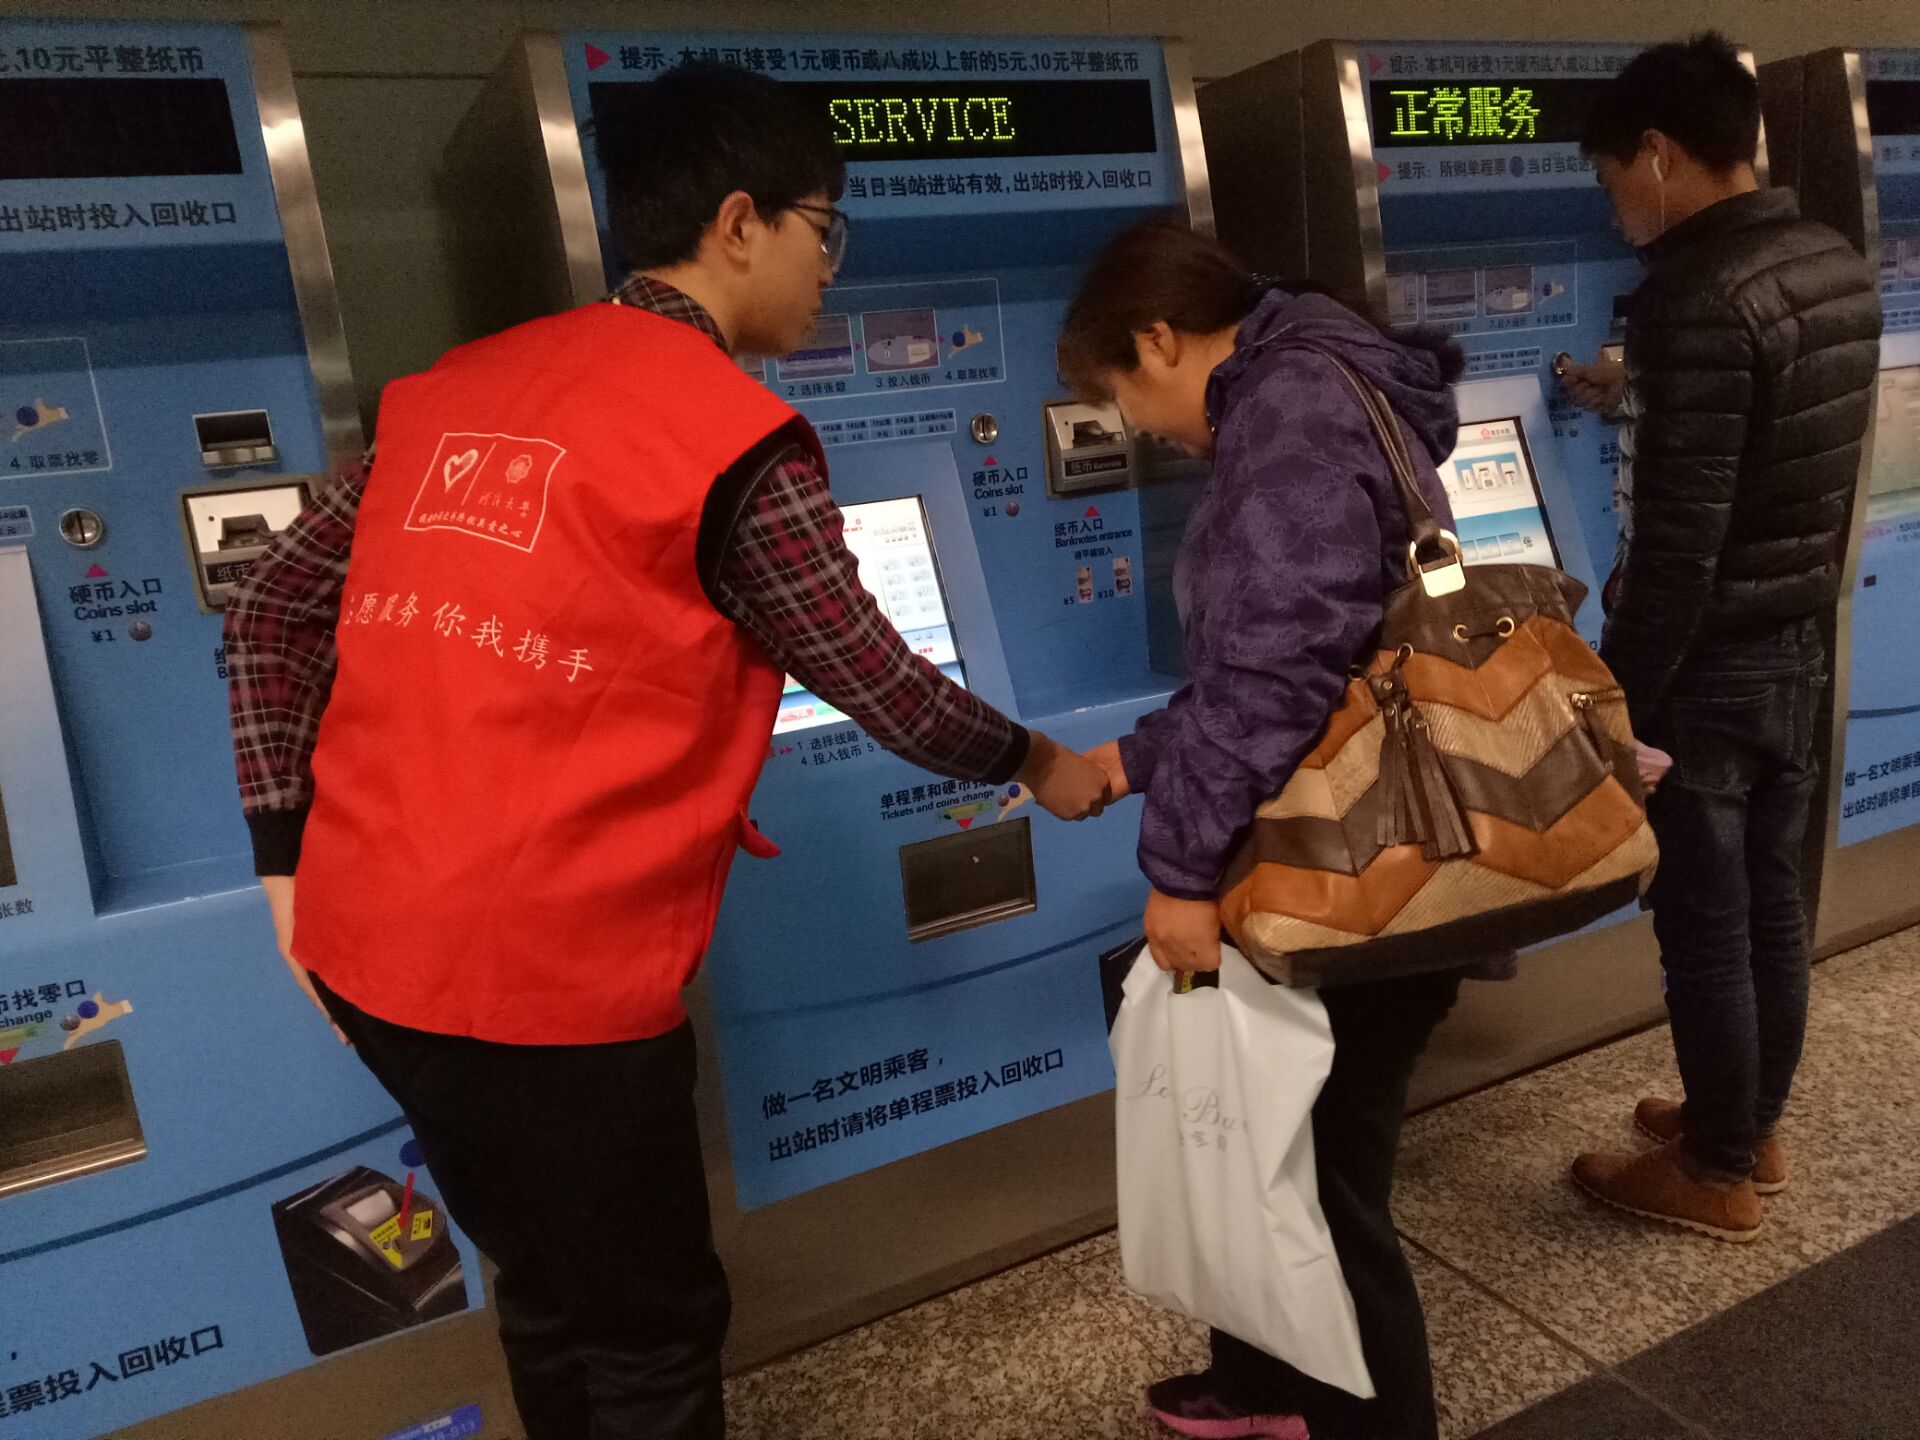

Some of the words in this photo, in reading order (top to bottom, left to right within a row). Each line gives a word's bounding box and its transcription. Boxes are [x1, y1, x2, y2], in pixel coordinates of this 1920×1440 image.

[829, 96, 1015, 144] SERVICE
[1390, 87, 1541, 140] 正常服务
[973, 467, 1028, 487] 硬币入口
[974, 486, 1003, 500] Coins
[1005, 484, 1024, 496] slot
[1054, 518, 1104, 538] 纸币入口
[1055, 534, 1098, 549] Banknotes
[1099, 528, 1133, 543] entrance
[69, 578, 162, 605] 硬币入口
[74, 604, 123, 622] Coins
[125, 599, 158, 615] slot
[91, 629, 116, 643] ¥1
[432, 602, 594, 683] 你我携手
[880, 807, 914, 821] Tickets
[916, 801, 934, 813] and
[936, 797, 960, 809] coins
[962, 790, 995, 803] change
[769, 1048, 1065, 1163] 出站时请将单程票投入回收口
